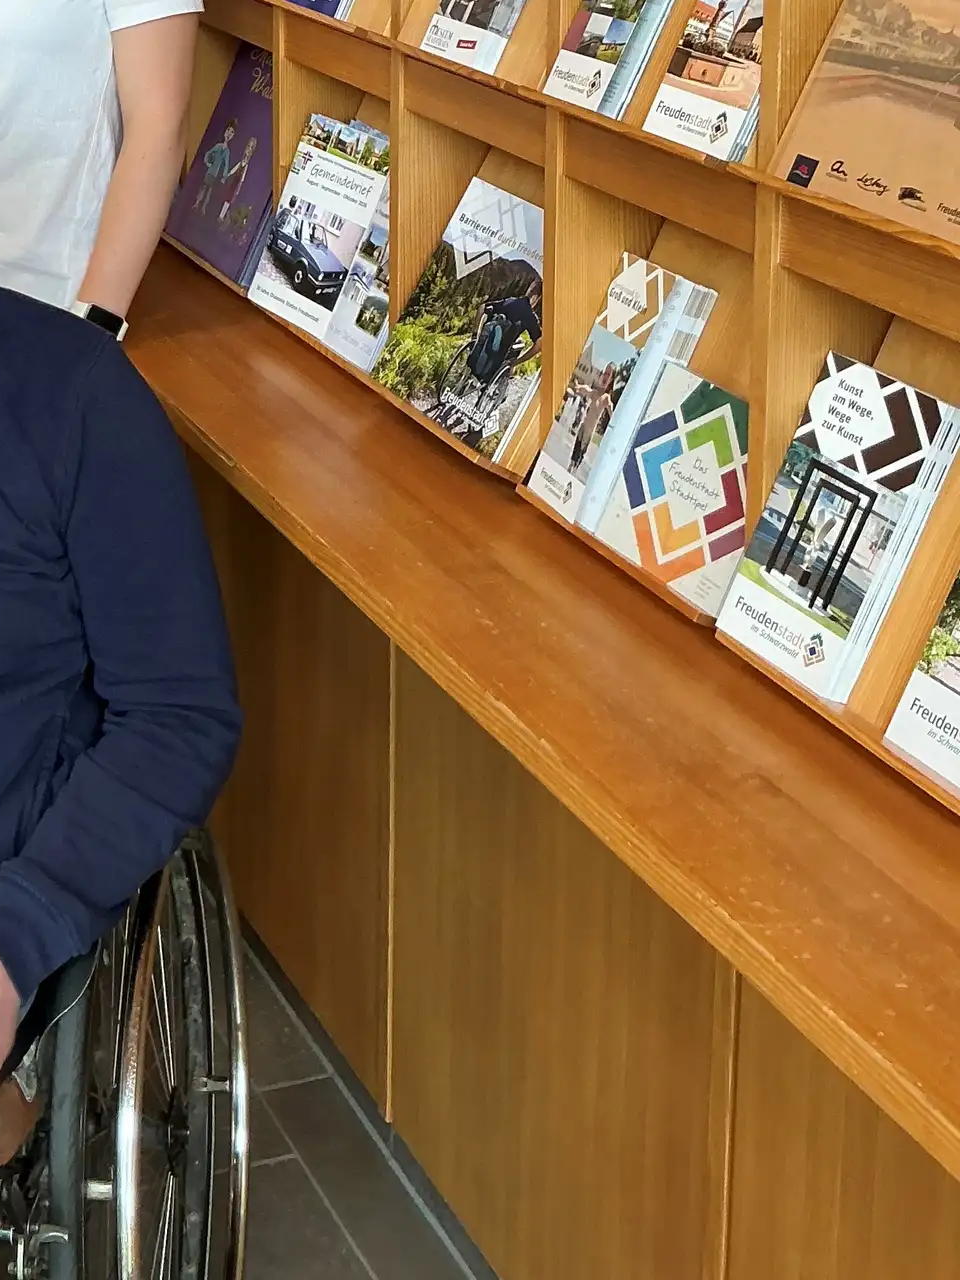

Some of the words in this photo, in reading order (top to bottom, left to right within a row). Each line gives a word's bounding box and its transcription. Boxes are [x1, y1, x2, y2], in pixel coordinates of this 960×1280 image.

[656, 101, 712, 130] Freudenstadt
[310, 164, 373, 198] Gemeindebrief
[459, 213, 499, 238] Barrierefrei
[497, 233, 517, 248] durch
[621, 296, 634, 307] und
[838, 378, 864, 398] Kunst
[440, 387, 487, 424] Freudenstadt
[828, 404, 852, 424] Wege
[832, 393, 846, 405] am
[848, 398, 874, 421] Wege,
[821, 419, 836, 431] zur
[837, 425, 863, 446] Kunst
[692, 456, 709, 474] Das
[669, 462, 720, 499] Freudenstadt
[735, 595, 804, 650] Freudenstadt
[750, 624, 759, 633] im
[759, 629, 800, 659] Schwarzwald
[927, 729, 937, 739] im
